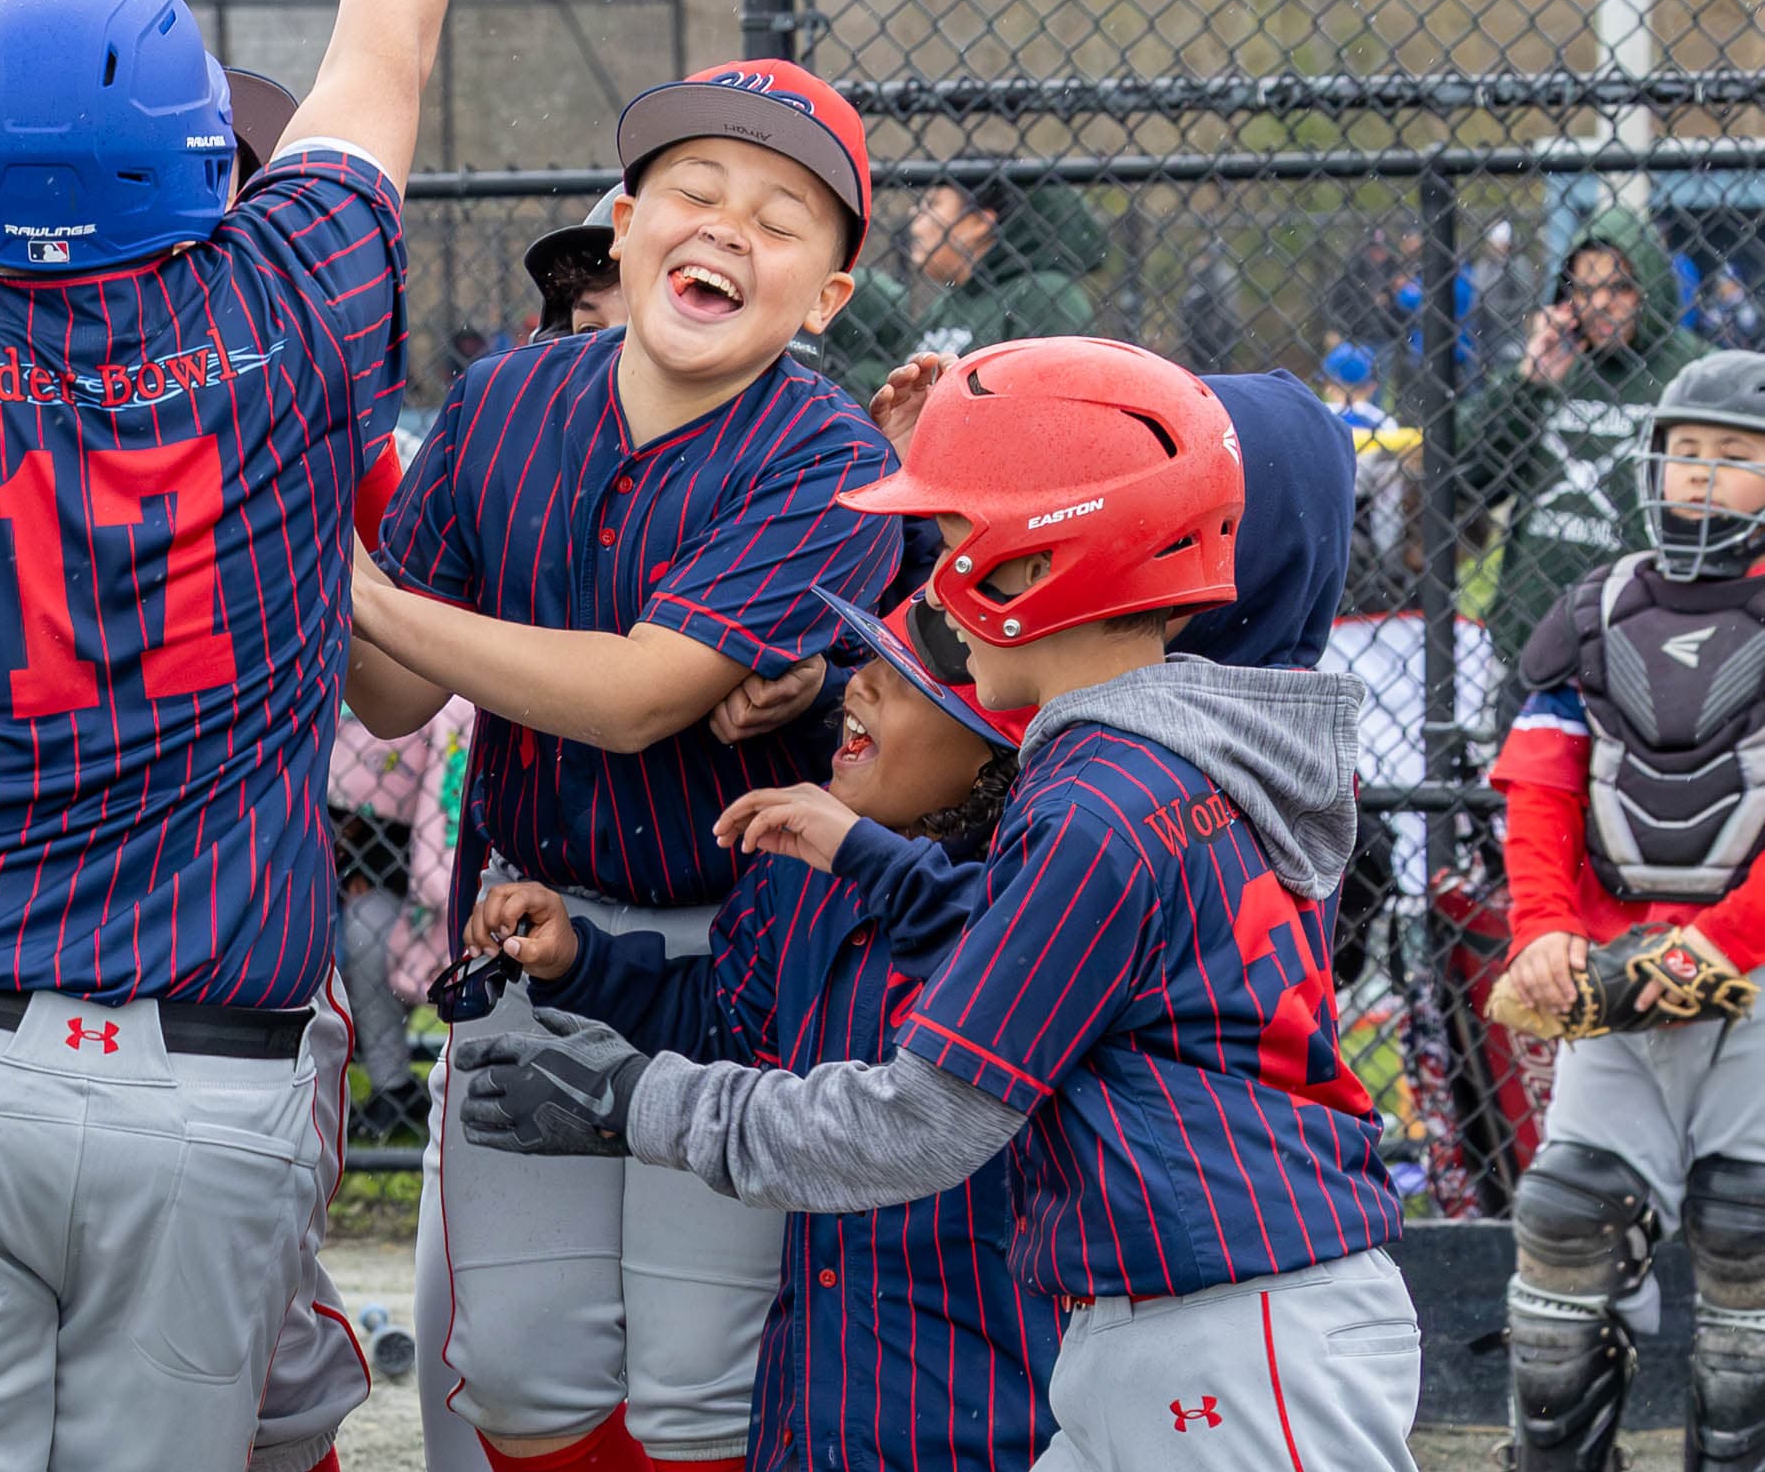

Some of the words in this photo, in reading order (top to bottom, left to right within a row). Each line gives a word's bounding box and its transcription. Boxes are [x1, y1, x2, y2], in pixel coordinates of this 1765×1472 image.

[4, 223, 97, 237] RAWLINGS
[96, 328, 237, 407] Bowl
[1028, 497, 1104, 530] EASTON
